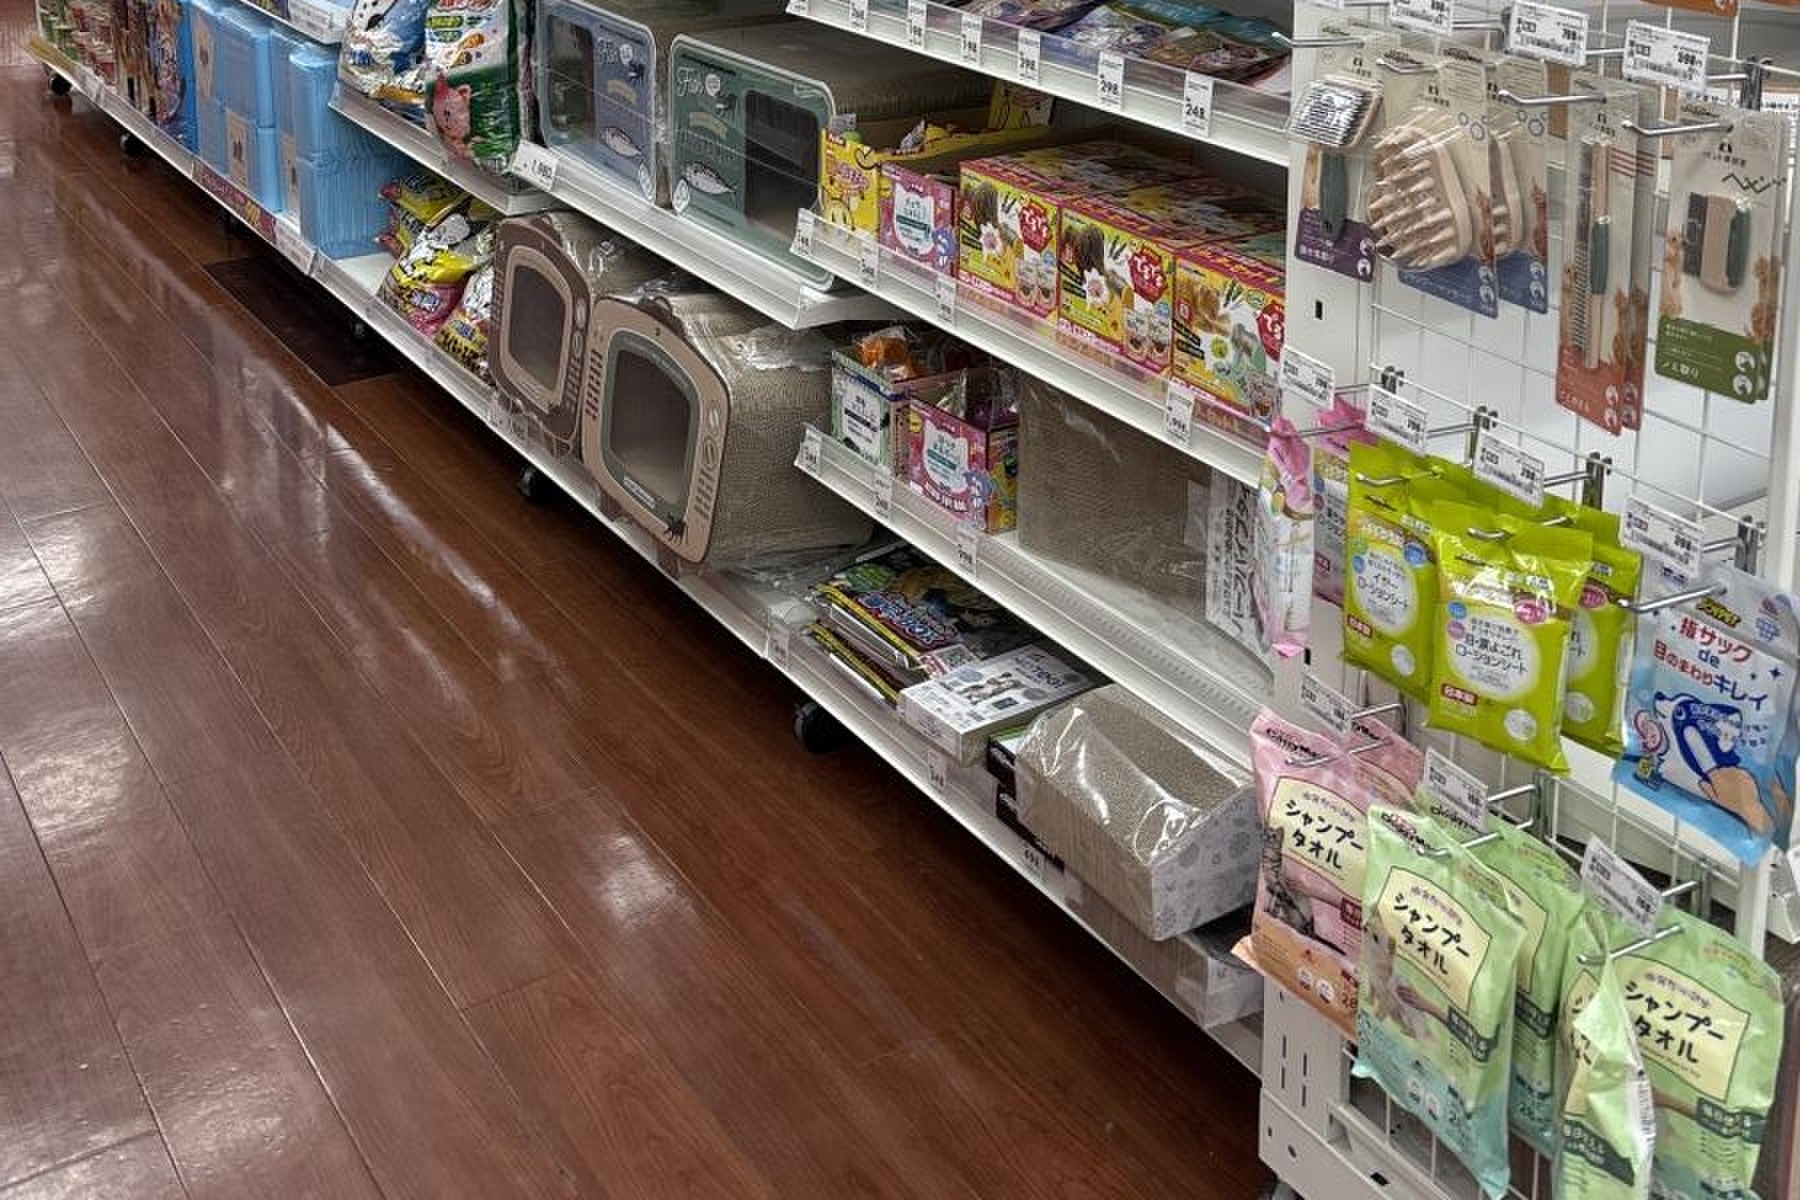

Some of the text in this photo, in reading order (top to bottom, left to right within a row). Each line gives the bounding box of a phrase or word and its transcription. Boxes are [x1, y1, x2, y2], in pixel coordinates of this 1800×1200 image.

[1679, 616, 1753, 662] 指サック
[1698, 650, 1721, 669] de
[1653, 639, 1769, 711] 目のまわりキレイ
[1285, 799, 1365, 852] シャンプー
[1292, 829, 1344, 870] タオル
[1393, 892, 1470, 958] シャンプー
[1400, 924, 1449, 975] タオル
[1623, 980, 1726, 1042] シャンプー
[1632, 1013, 1700, 1065] タオル
